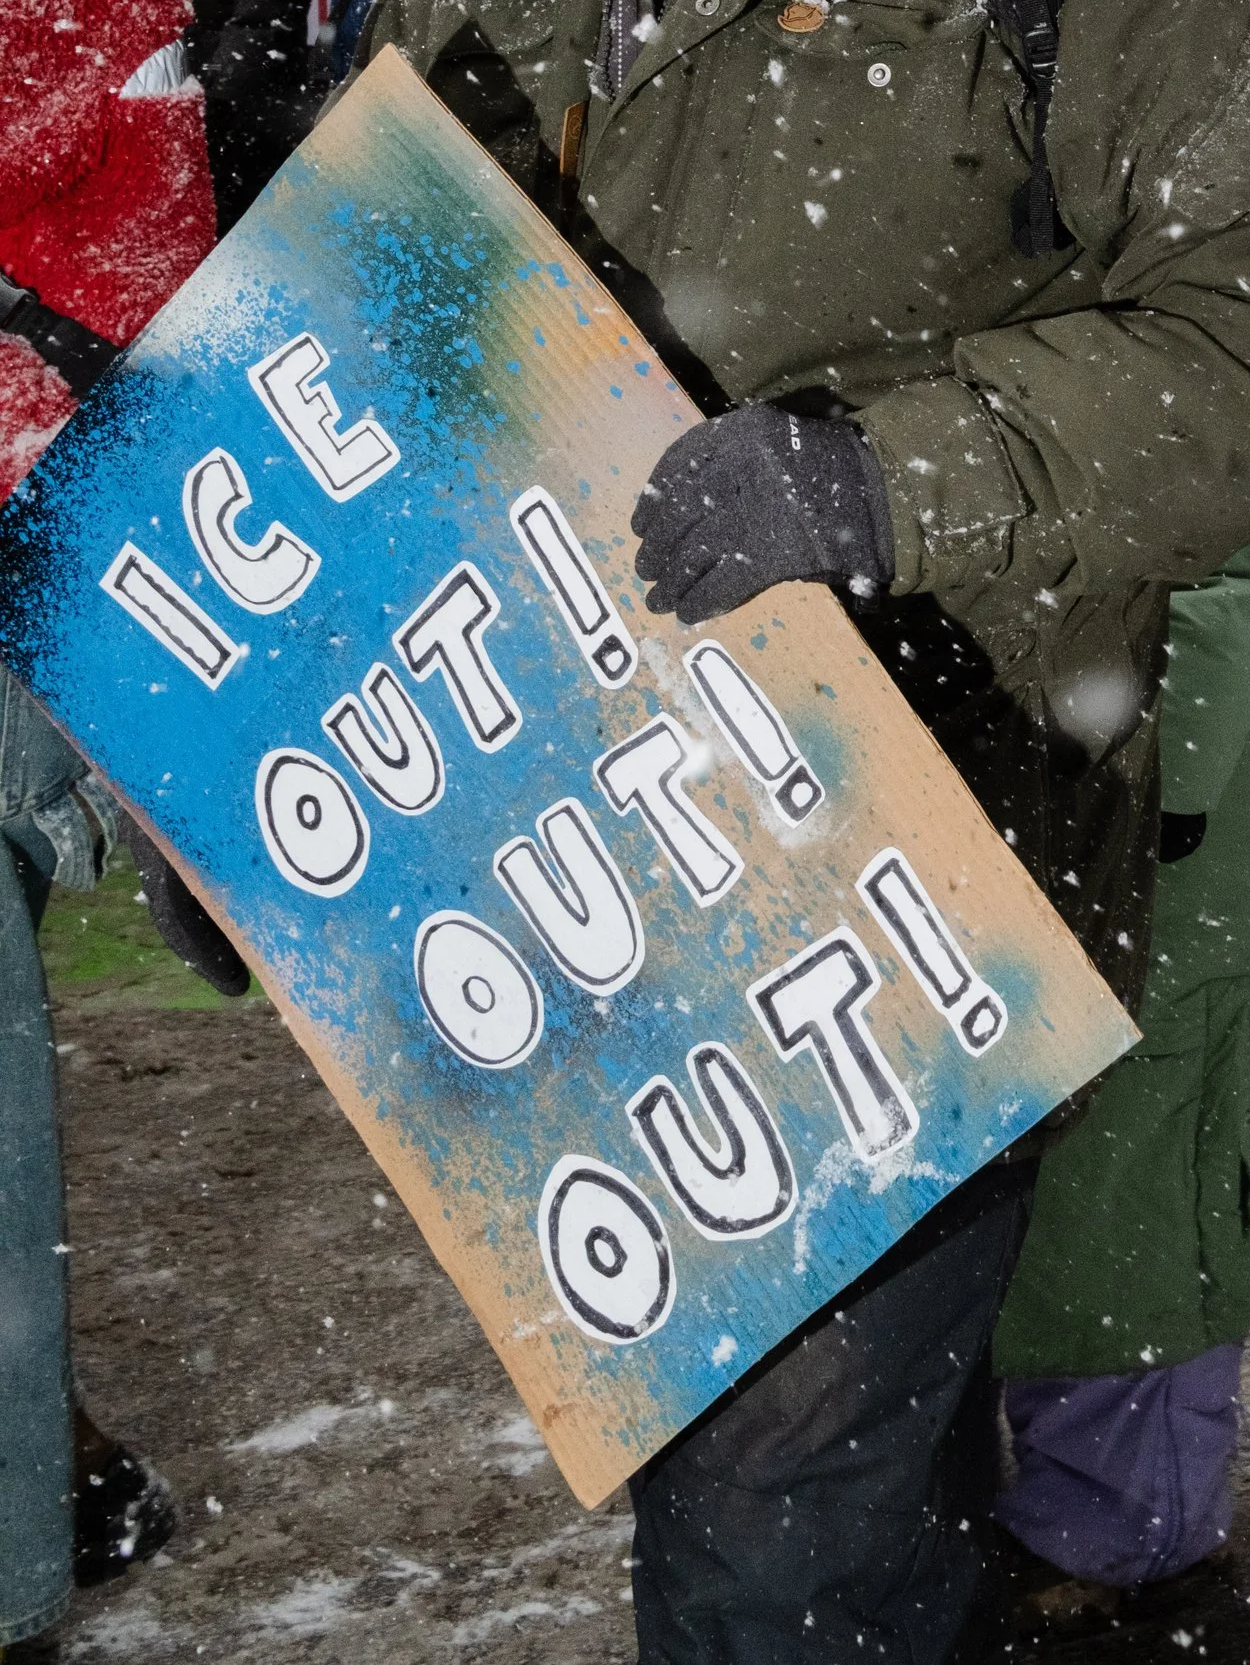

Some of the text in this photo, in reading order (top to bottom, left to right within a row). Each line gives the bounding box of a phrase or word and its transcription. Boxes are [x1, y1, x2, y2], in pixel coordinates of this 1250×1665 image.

[99, 332, 401, 690] ICE
[254, 485, 639, 898] OUT!
[413, 639, 825, 1068] OUT!
[538, 847, 1008, 1345] OUT!
